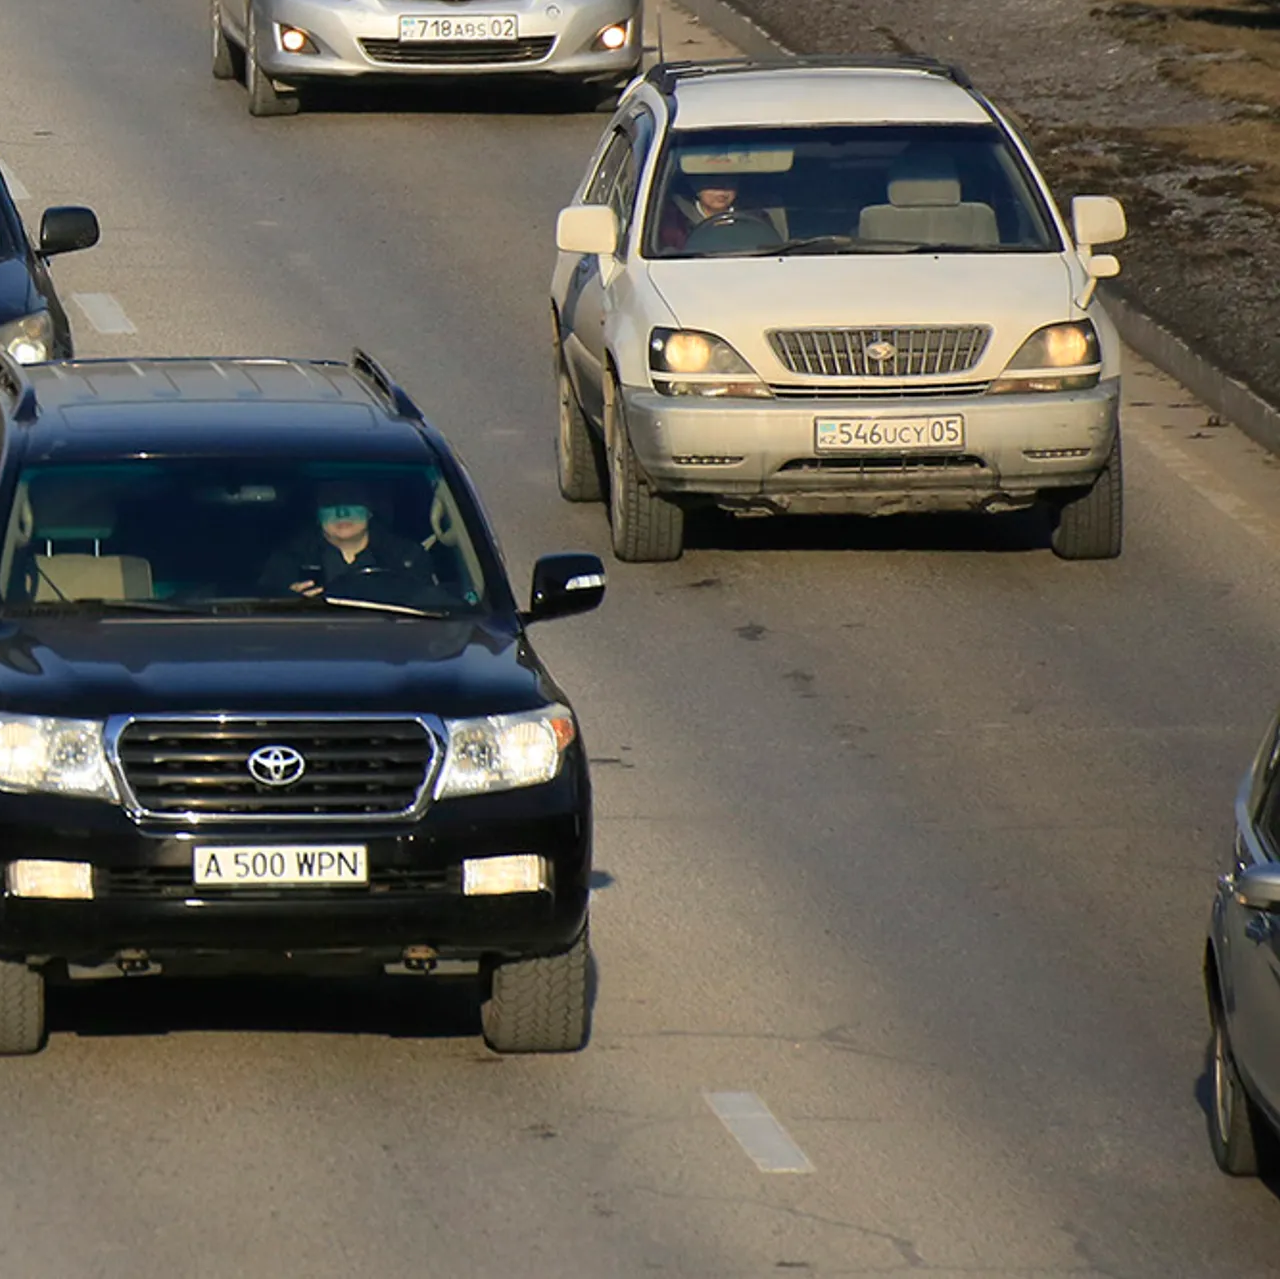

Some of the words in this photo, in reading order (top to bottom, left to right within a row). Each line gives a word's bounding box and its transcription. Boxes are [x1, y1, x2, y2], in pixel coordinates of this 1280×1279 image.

[491, 19, 514, 37] 02
[930, 419, 959, 442] 05
[204, 852, 223, 878] A
[233, 851, 286, 879] 500
[295, 851, 358, 877] WPN
